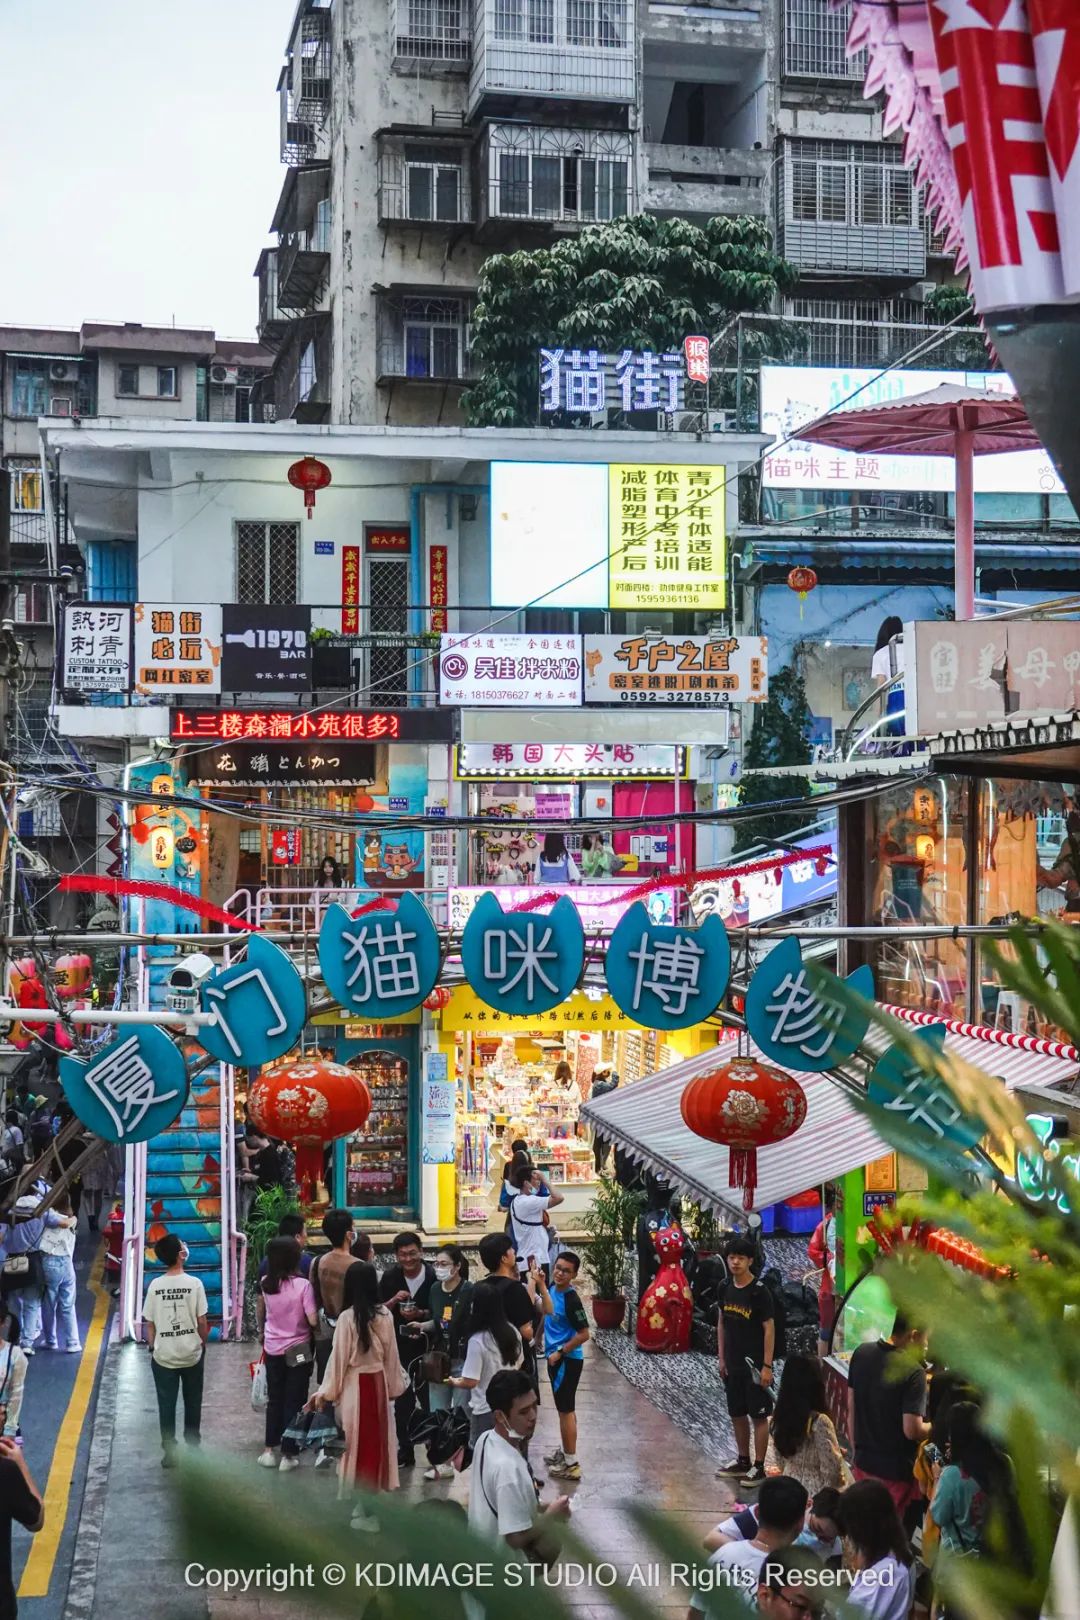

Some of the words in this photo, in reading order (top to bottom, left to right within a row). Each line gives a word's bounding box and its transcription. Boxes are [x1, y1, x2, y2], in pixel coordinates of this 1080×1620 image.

[541, 348, 682, 412] 猫街
[765, 457, 880, 480] 猫咪主题
[621, 470, 648, 571] 减脂塑形产后
[654, 470, 680, 571] 体育中考培训
[687, 471, 713, 571] 青少年体适能
[152, 611, 202, 634] 猫街
[71, 635, 124, 656] 刺青
[152, 637, 202, 660] 必玩
[255, 630, 307, 648] 1970
[144, 669, 210, 683] 网红密室
[474, 656, 580, 680] 吴佳拌米粉
[614, 675, 678, 689] 密室逃脱
[689, 675, 735, 689] 剧本杀
[471, 690, 529, 699] 18150376627
[533, 689, 577, 699] 对面二楼
[620, 691, 730, 702] 0592-3278573
